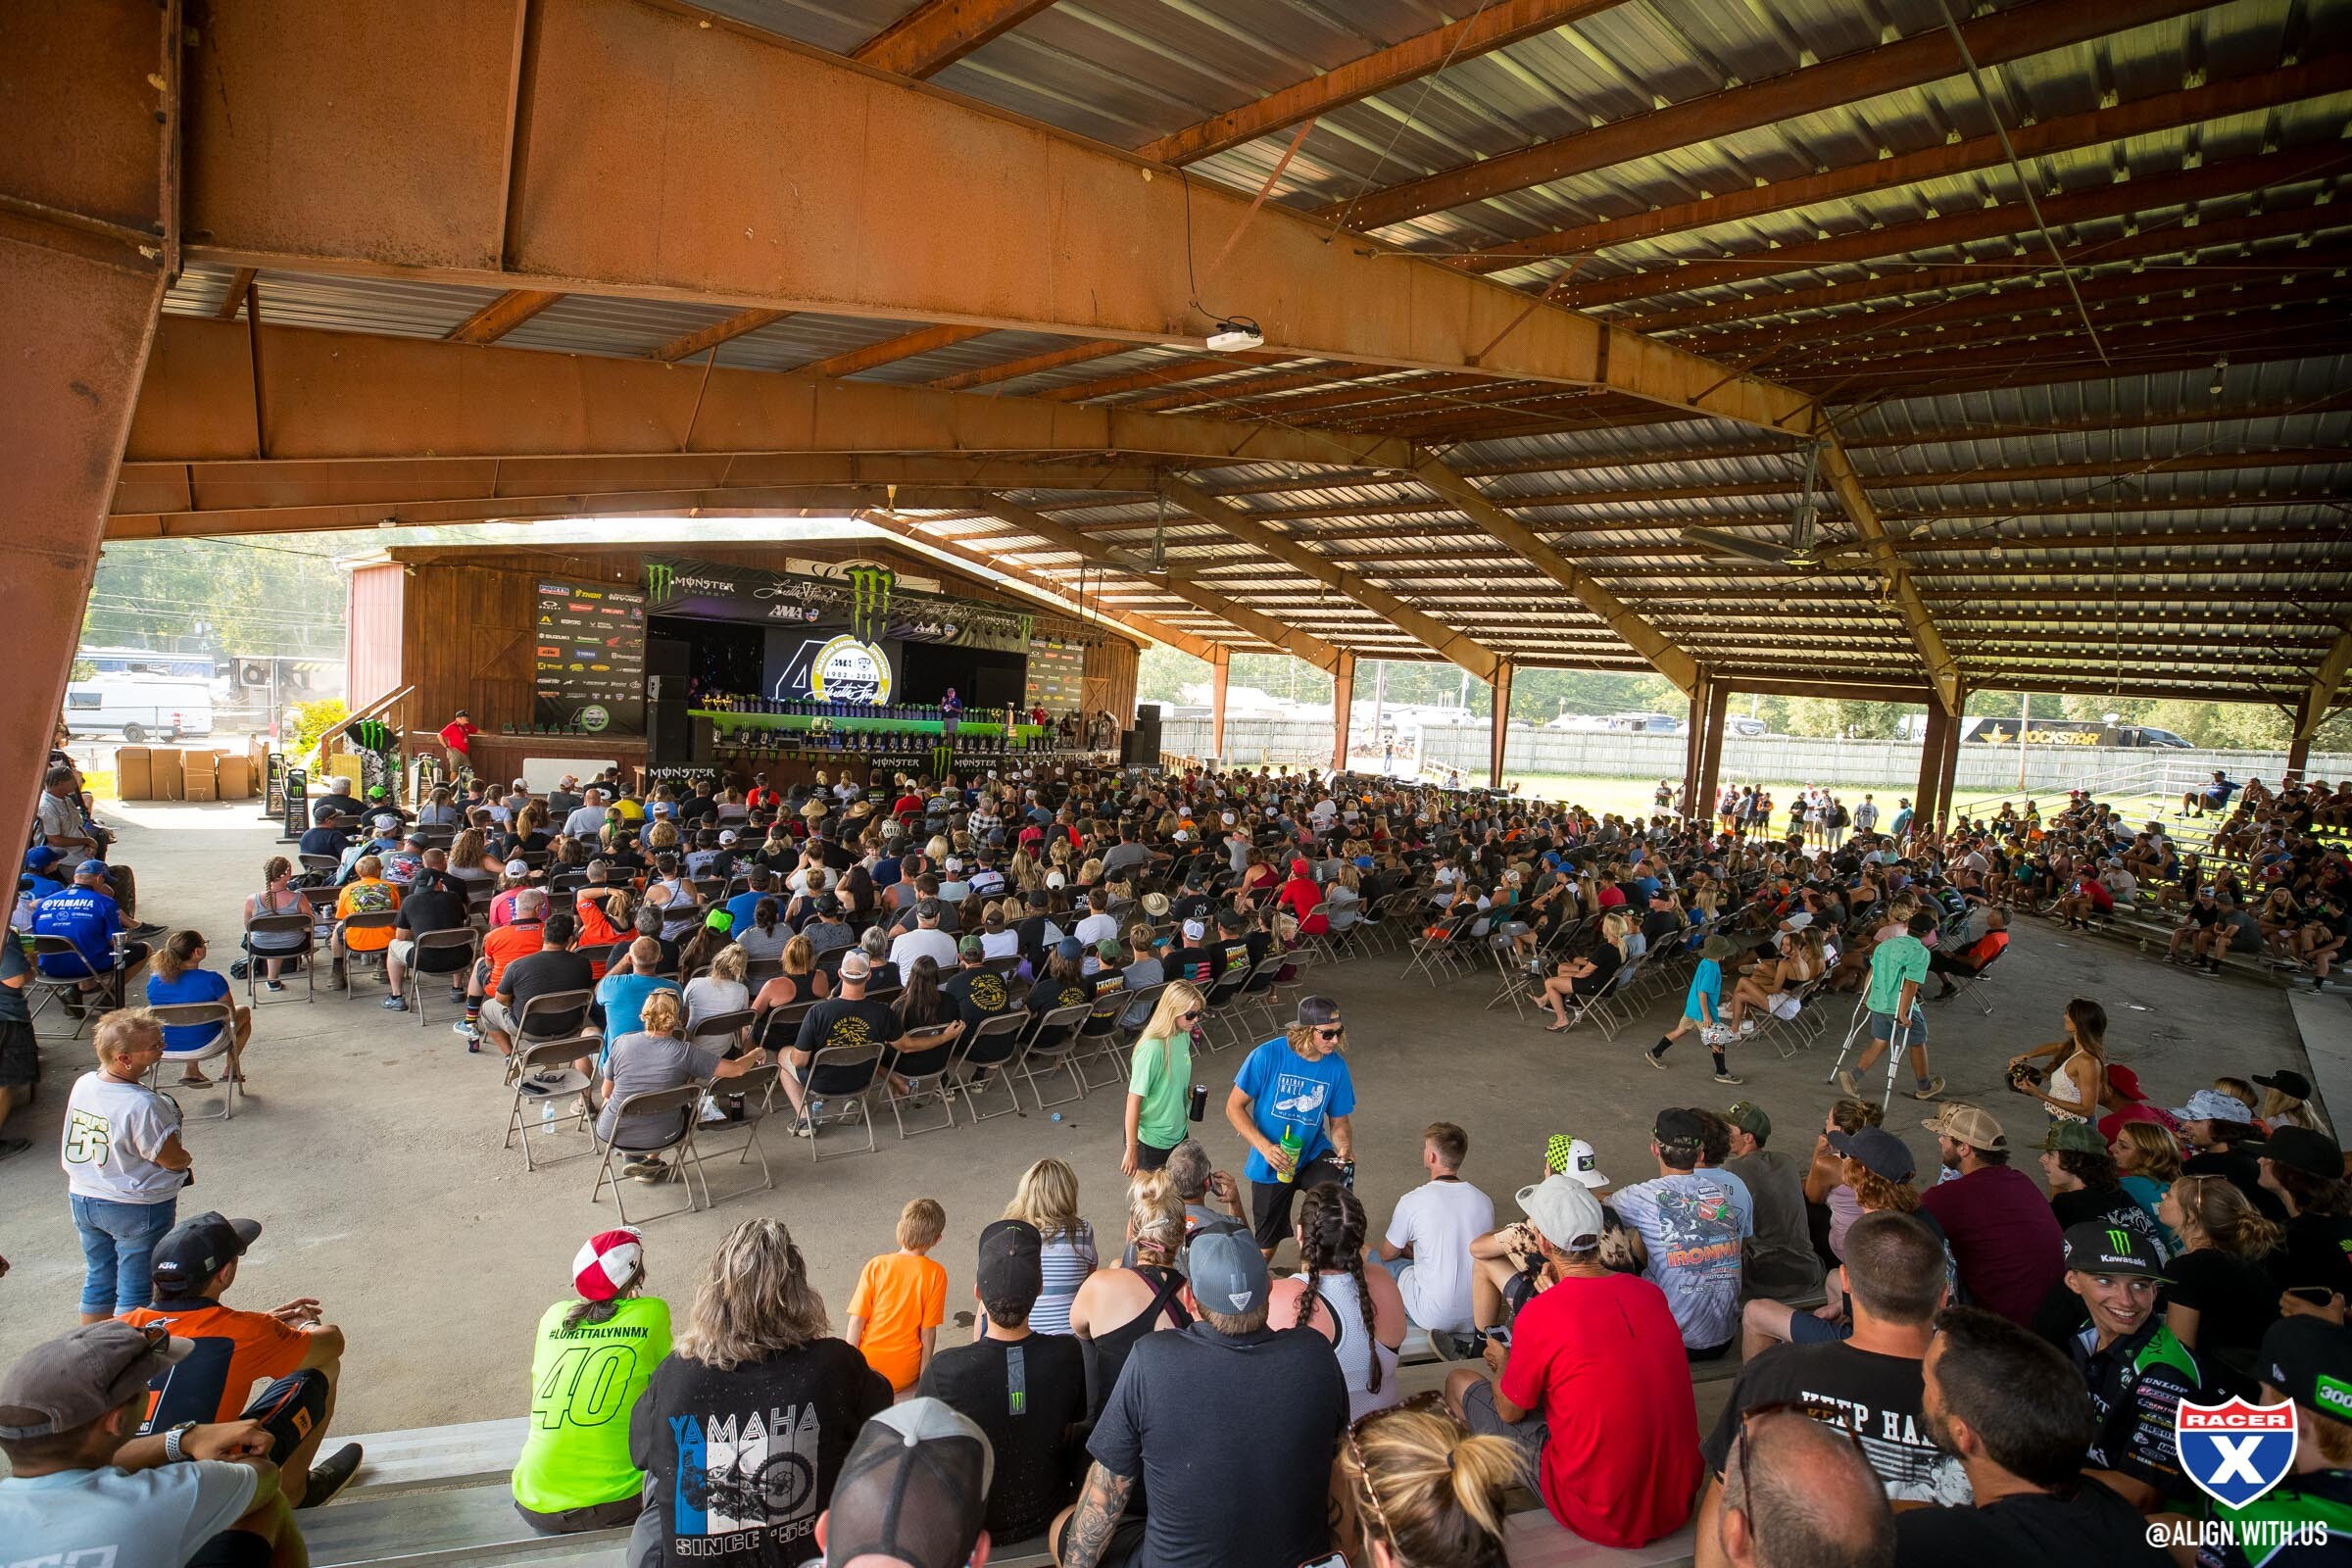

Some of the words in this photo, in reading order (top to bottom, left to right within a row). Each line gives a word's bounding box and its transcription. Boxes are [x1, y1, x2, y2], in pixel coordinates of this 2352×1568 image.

[675, 576, 735, 593] MONSTER
[768, 605, 804, 618] AMA
[872, 757, 919, 767] MONSTER
[955, 758, 997, 767] MONSTER
[649, 766, 716, 779] MONSTER
[1128, 766, 1160, 775] MONTER
[52, 899, 94, 908] YAMAHA
[833, 1017, 848, 1030] MOTO
[1280, 1084, 1301, 1096] HALL
[66, 1122, 110, 1167] 56
[1667, 1241, 1741, 1268] IRONMA
[2100, 1254, 2146, 1267] Kawasaki
[158, 1261, 178, 1270] KTM
[549, 1326, 649, 1340] #LORETTALYNNMX
[533, 1344, 637, 1430] 40
[2140, 1376, 2188, 1394] DUNLOP
[668, 1401, 821, 1445] YAMAHA
[675, 1530, 760, 1556] SINCE
